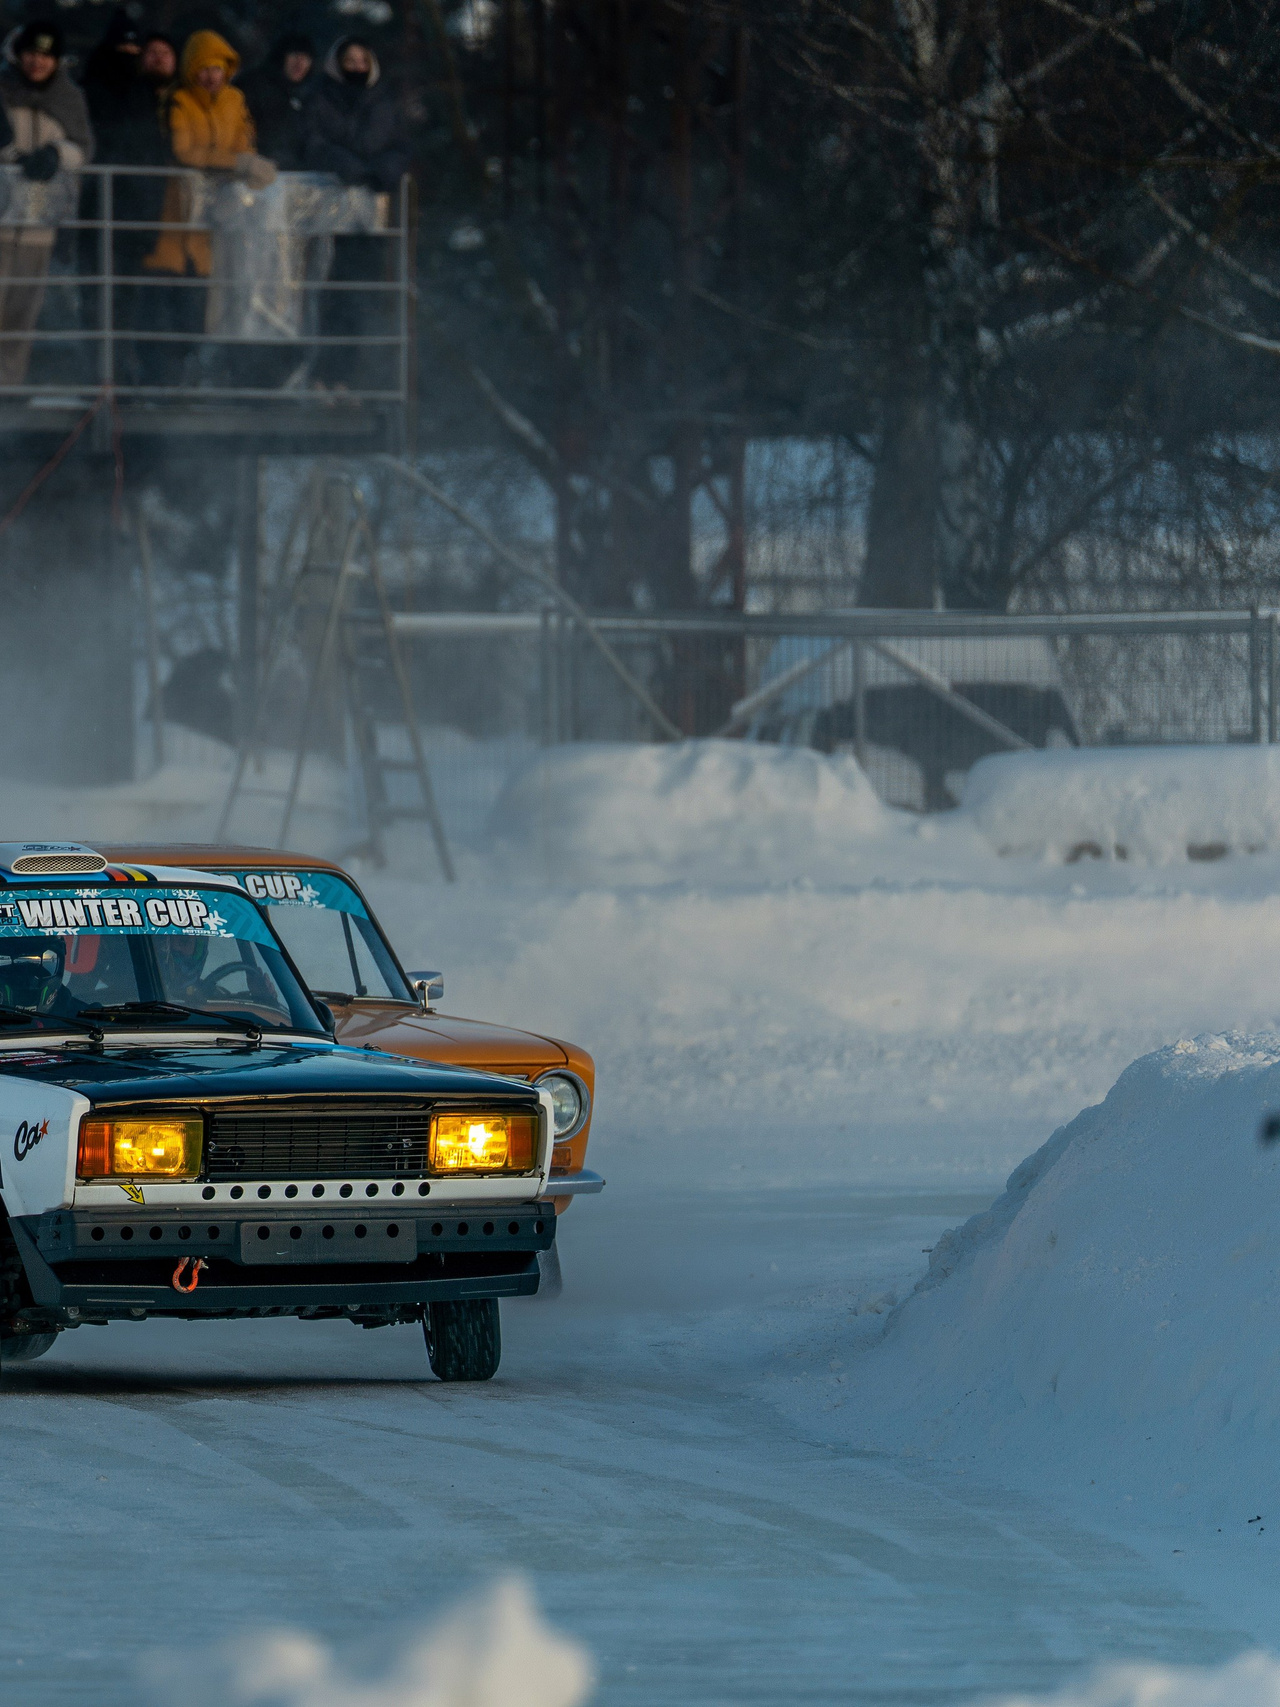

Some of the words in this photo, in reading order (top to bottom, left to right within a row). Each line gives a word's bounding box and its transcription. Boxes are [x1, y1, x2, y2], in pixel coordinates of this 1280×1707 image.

[244, 874, 303, 899] CUP
[16, 899, 145, 928] WINTER
[143, 899, 209, 928] CUP
